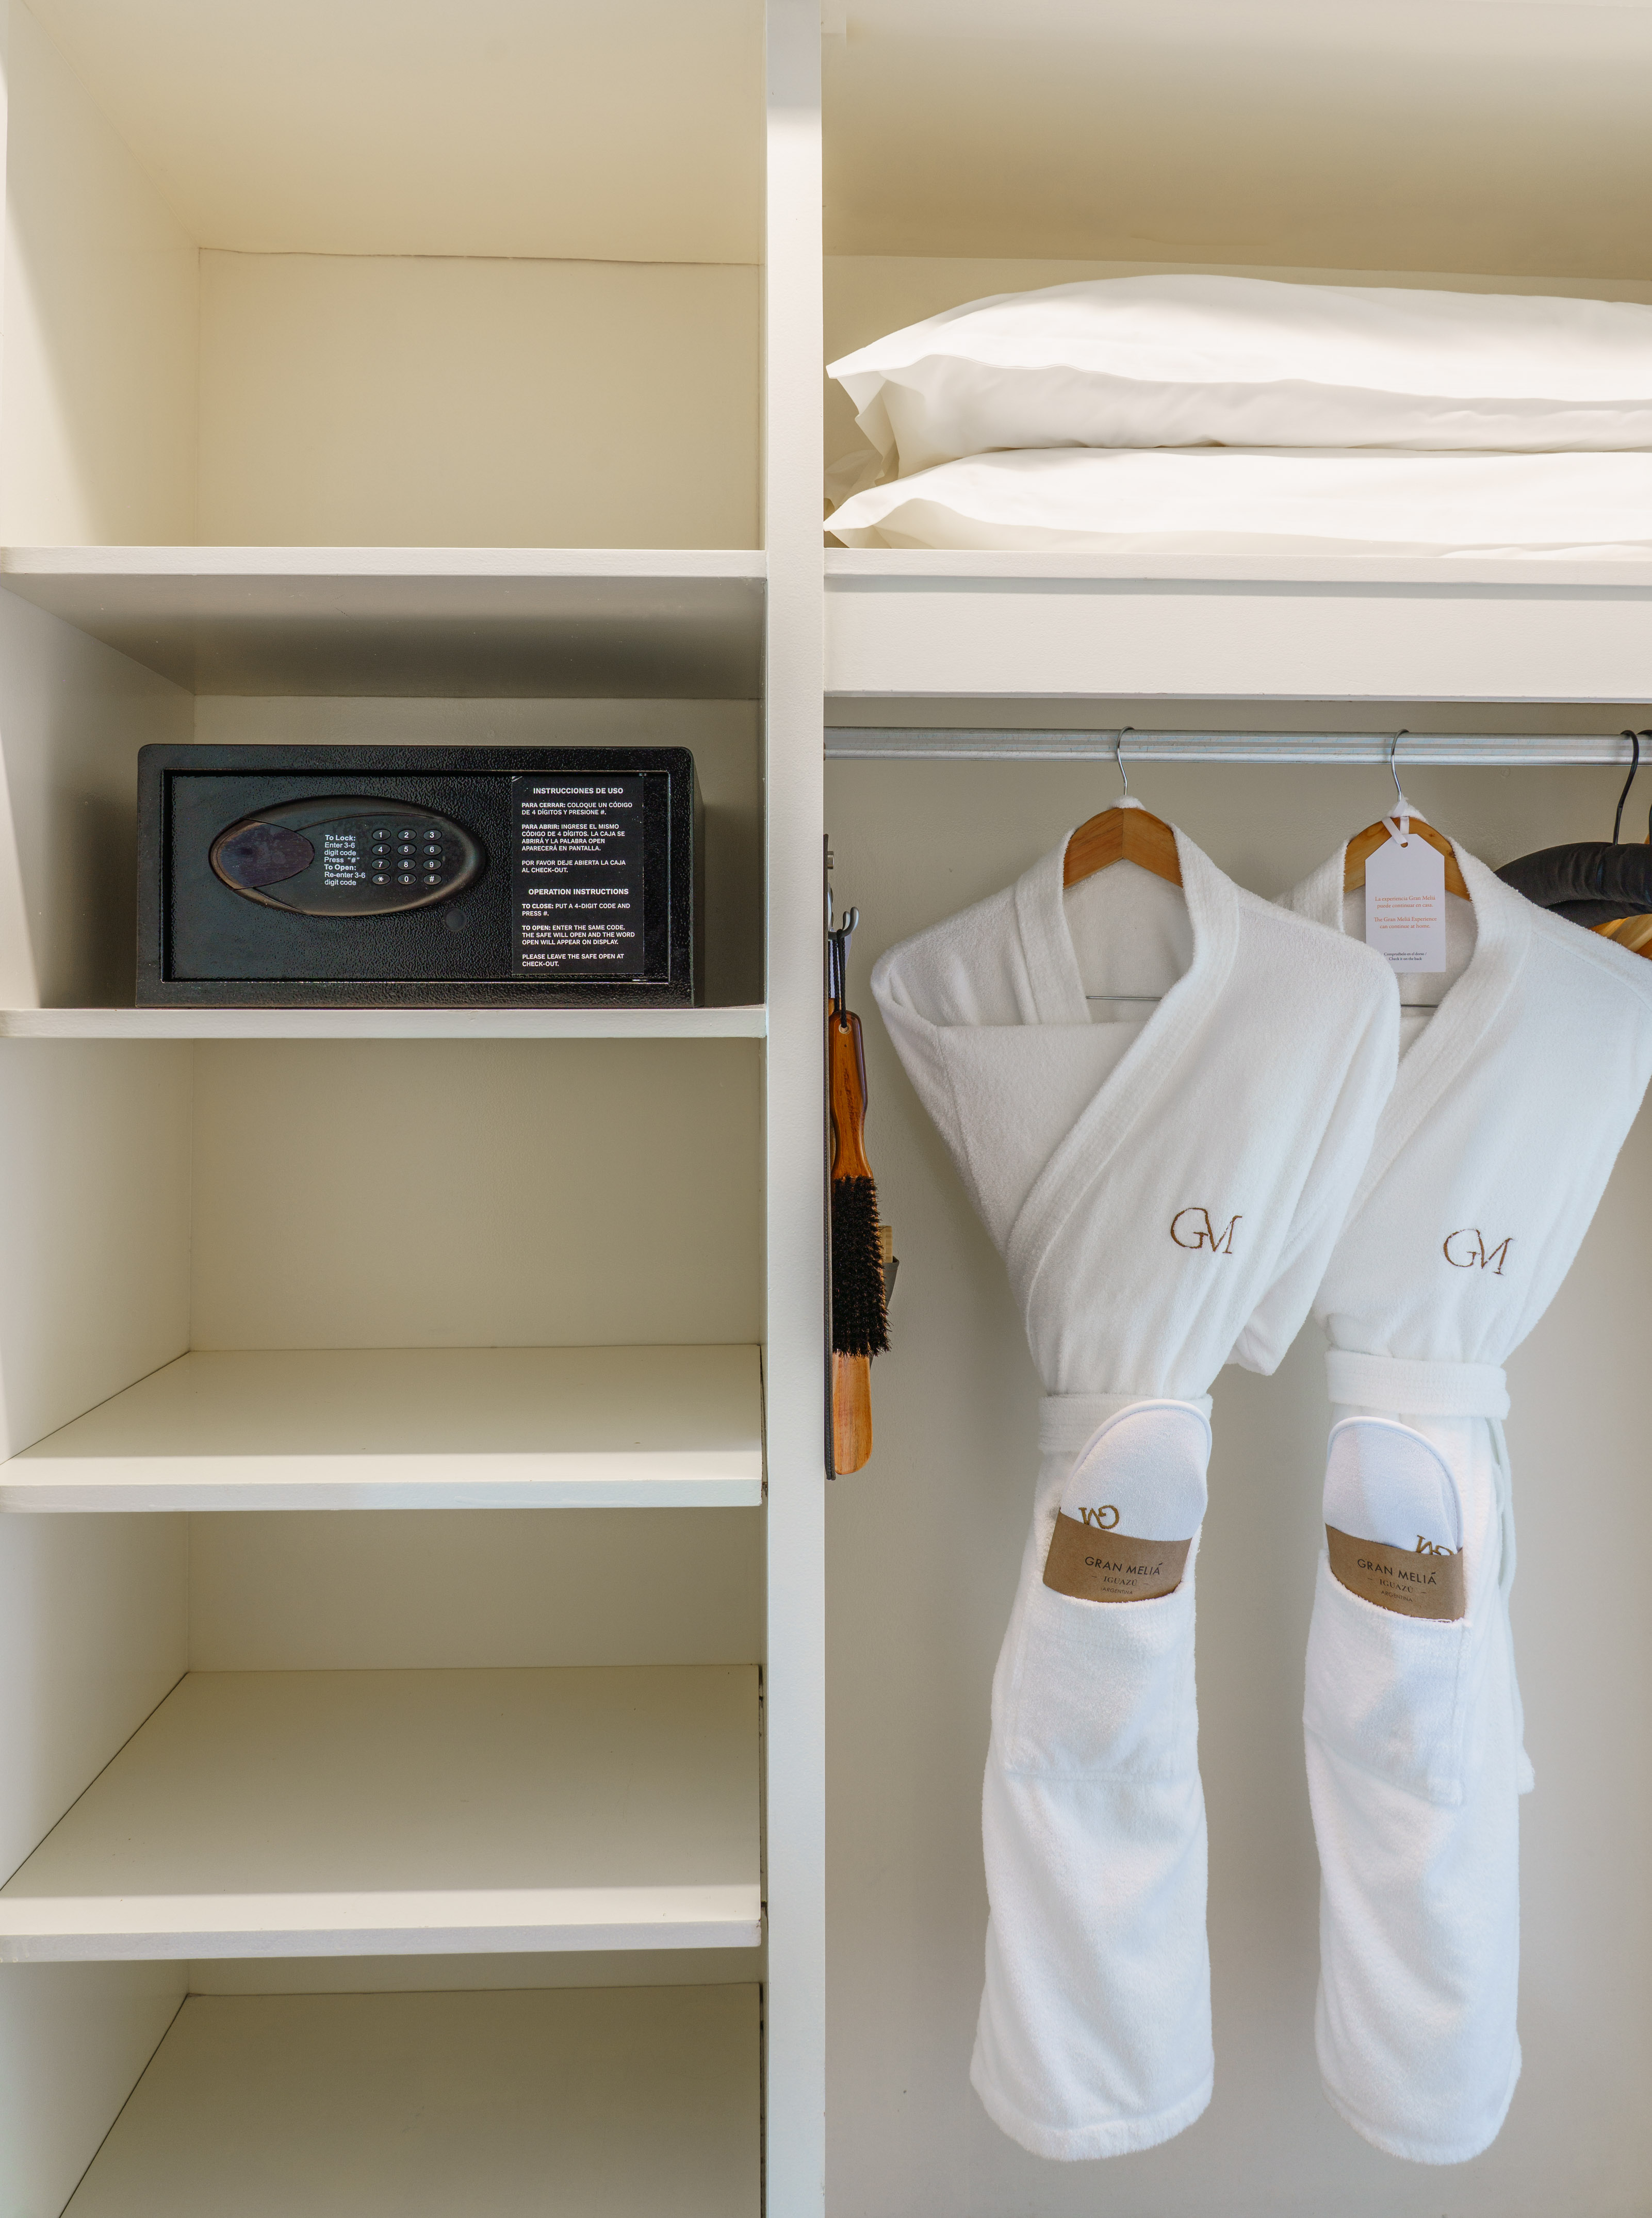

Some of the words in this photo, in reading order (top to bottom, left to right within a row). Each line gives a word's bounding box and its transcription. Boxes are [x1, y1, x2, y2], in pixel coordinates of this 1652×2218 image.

[1170, 1207, 1242, 1254] GM
[1443, 1228, 1514, 1276] GM
[1085, 1556, 1122, 1572] GRAN
[1126, 1562, 1163, 1575] MELIÁ
[1357, 1559, 1393, 1576] GRAN
[1398, 1570, 1436, 1585] MELIÁ
[1103, 1576, 1138, 1586] IGUAZÚ
[1380, 1578, 1413, 1593] IGUAZÚ
[1381, 1591, 1413, 1602] ARGENTINA
